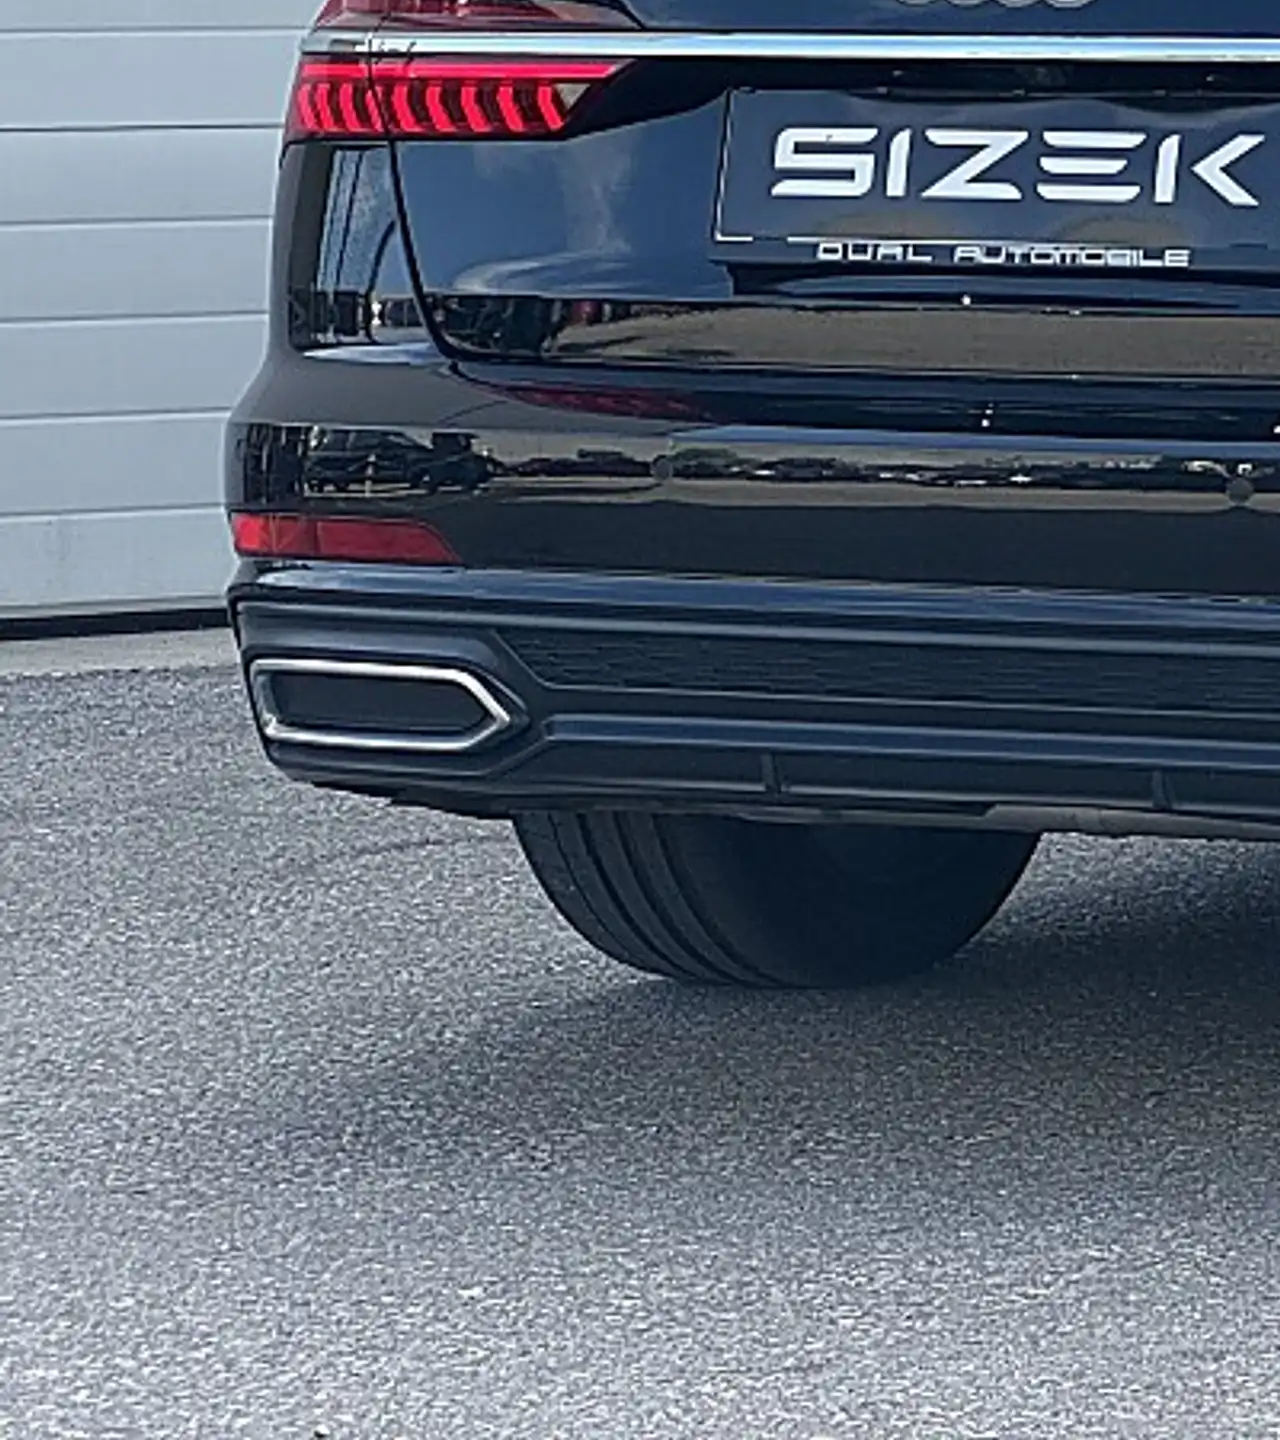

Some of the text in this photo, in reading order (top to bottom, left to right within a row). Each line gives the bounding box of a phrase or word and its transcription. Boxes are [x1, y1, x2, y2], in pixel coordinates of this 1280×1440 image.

[771, 127, 1266, 207] SIZEK
[816, 242, 1191, 268] DUAL AUTOMOBILE
